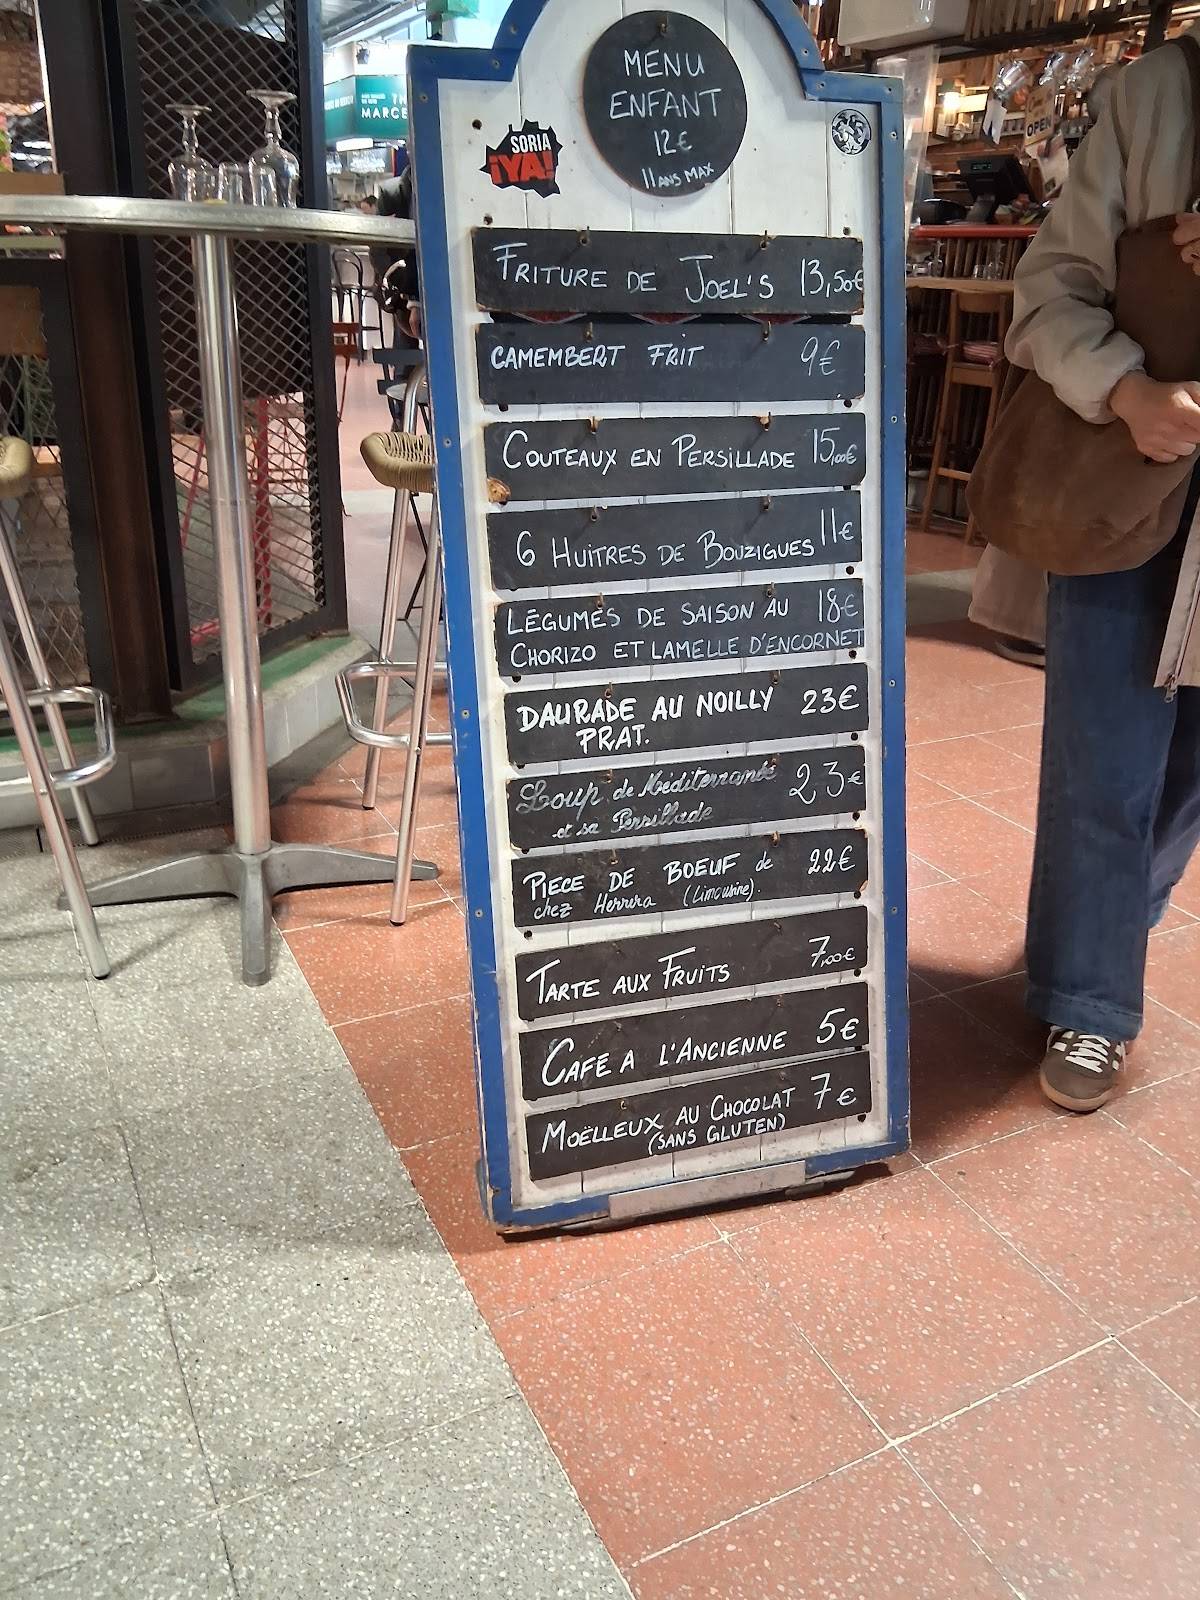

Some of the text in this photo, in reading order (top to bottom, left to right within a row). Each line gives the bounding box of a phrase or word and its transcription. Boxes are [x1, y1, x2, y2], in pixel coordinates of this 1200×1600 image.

[624, 49, 705, 78] MENU
[609, 87, 722, 119] ENFANT
[510, 132, 552, 154] SORIA
[653, 128, 693, 157] 12€
[1026, 118, 1053, 137] OPEN
[488, 150, 554, 185] ¡YA!
[684, 162, 715, 183] MAX
[492, 242, 864, 304] FRITURE DE JOEL'S 13,50€
[490, 336, 841, 377] CAMEMBERT FRIT 9€
[502, 429, 617, 476] COUTEAUX
[630, 448, 661, 468] EN
[516, 530, 536, 566] 6
[656, 543, 685, 566] DE
[696, 528, 815, 569] BOUZIGUES
[820, 508, 855, 546] 11€
[637, 606, 666, 629] DE
[682, 600, 756, 627] SAISON
[765, 597, 790, 617] AU
[818, 588, 860, 623] 18€
[510, 627, 865, 669] CHORIZO ET LAMELLE D'ENCORNET
[516, 684, 861, 733] DAURADE AU NOILLY 23€
[575, 722, 650, 754] PRAT.
[612, 777, 635, 801] de
[610, 800, 714, 834] Persillade
[523, 845, 856, 901] PIECE DE BOEUF de 22€
[525, 959, 600, 1004] TARTE
[612, 973, 651, 995] AUX
[619, 1049, 635, 1074] A
[658, 1030, 788, 1067] L'ANCIENNE
[815, 1007, 860, 1044] 5€
[675, 1104, 700, 1126] AU
[709, 1086, 796, 1119] CHOCOLAT
[648, 1112, 787, 1156] (SANS GLUTEN)
